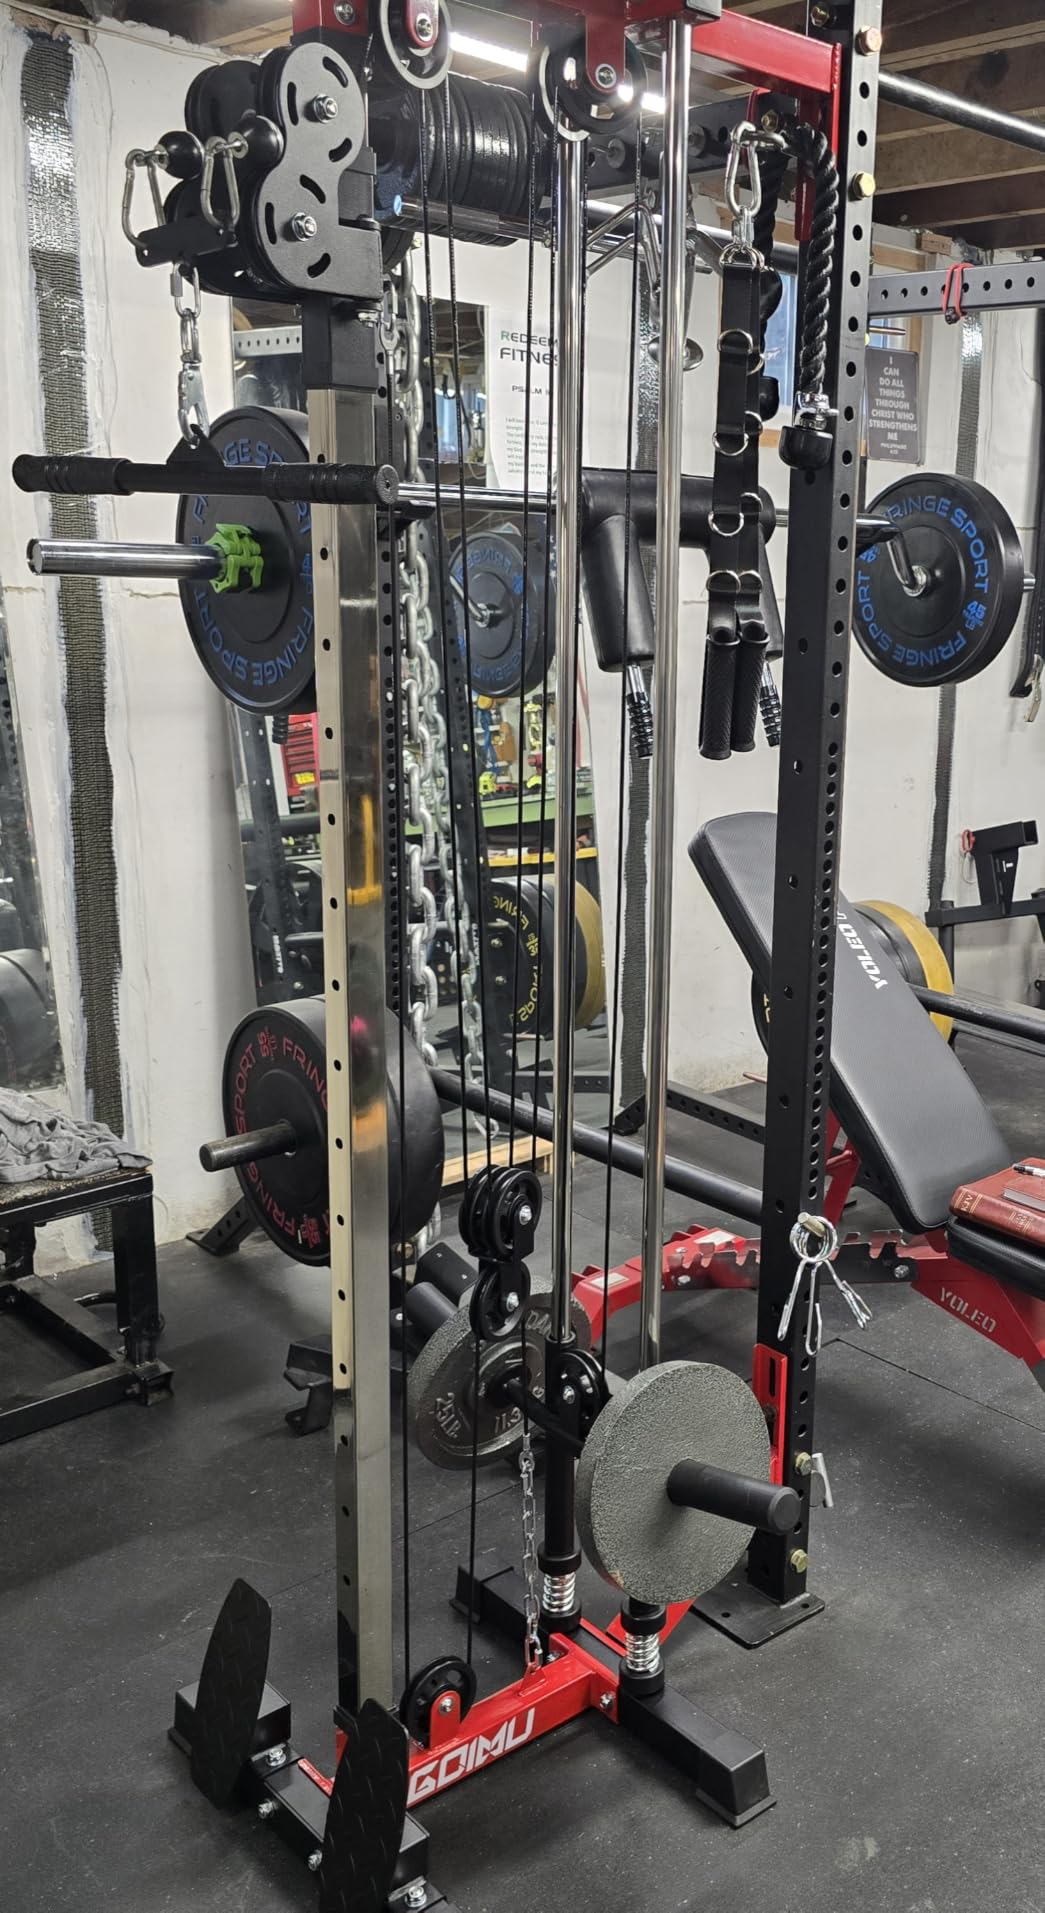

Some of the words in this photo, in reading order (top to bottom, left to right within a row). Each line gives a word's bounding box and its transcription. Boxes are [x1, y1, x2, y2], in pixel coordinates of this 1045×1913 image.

[883, 367, 900, 377] CAN
[879, 377, 890, 386] DO
[891, 378, 904, 388] ALL
[511, 385, 542, 394] PSLM
[879, 388, 905, 399] THINGS
[875, 398, 910, 410] THROUGH
[871, 409, 895, 419] CHRIST
[896, 411, 914, 420] WHO
[869, 419, 917, 432] STRENGTHENS
[887, 432, 898, 440] ME
[883, 496, 951, 522] RINGE
[838, 923, 888, 989] YOLEO
[283, 1036, 328, 1112] FRING
[248, 1161, 296, 1236] FRING
[961, 1194, 974, 1212] KJV
[939, 1287, 997, 1333] YOLEO
[407, 1707, 536, 1808] GOIMU
